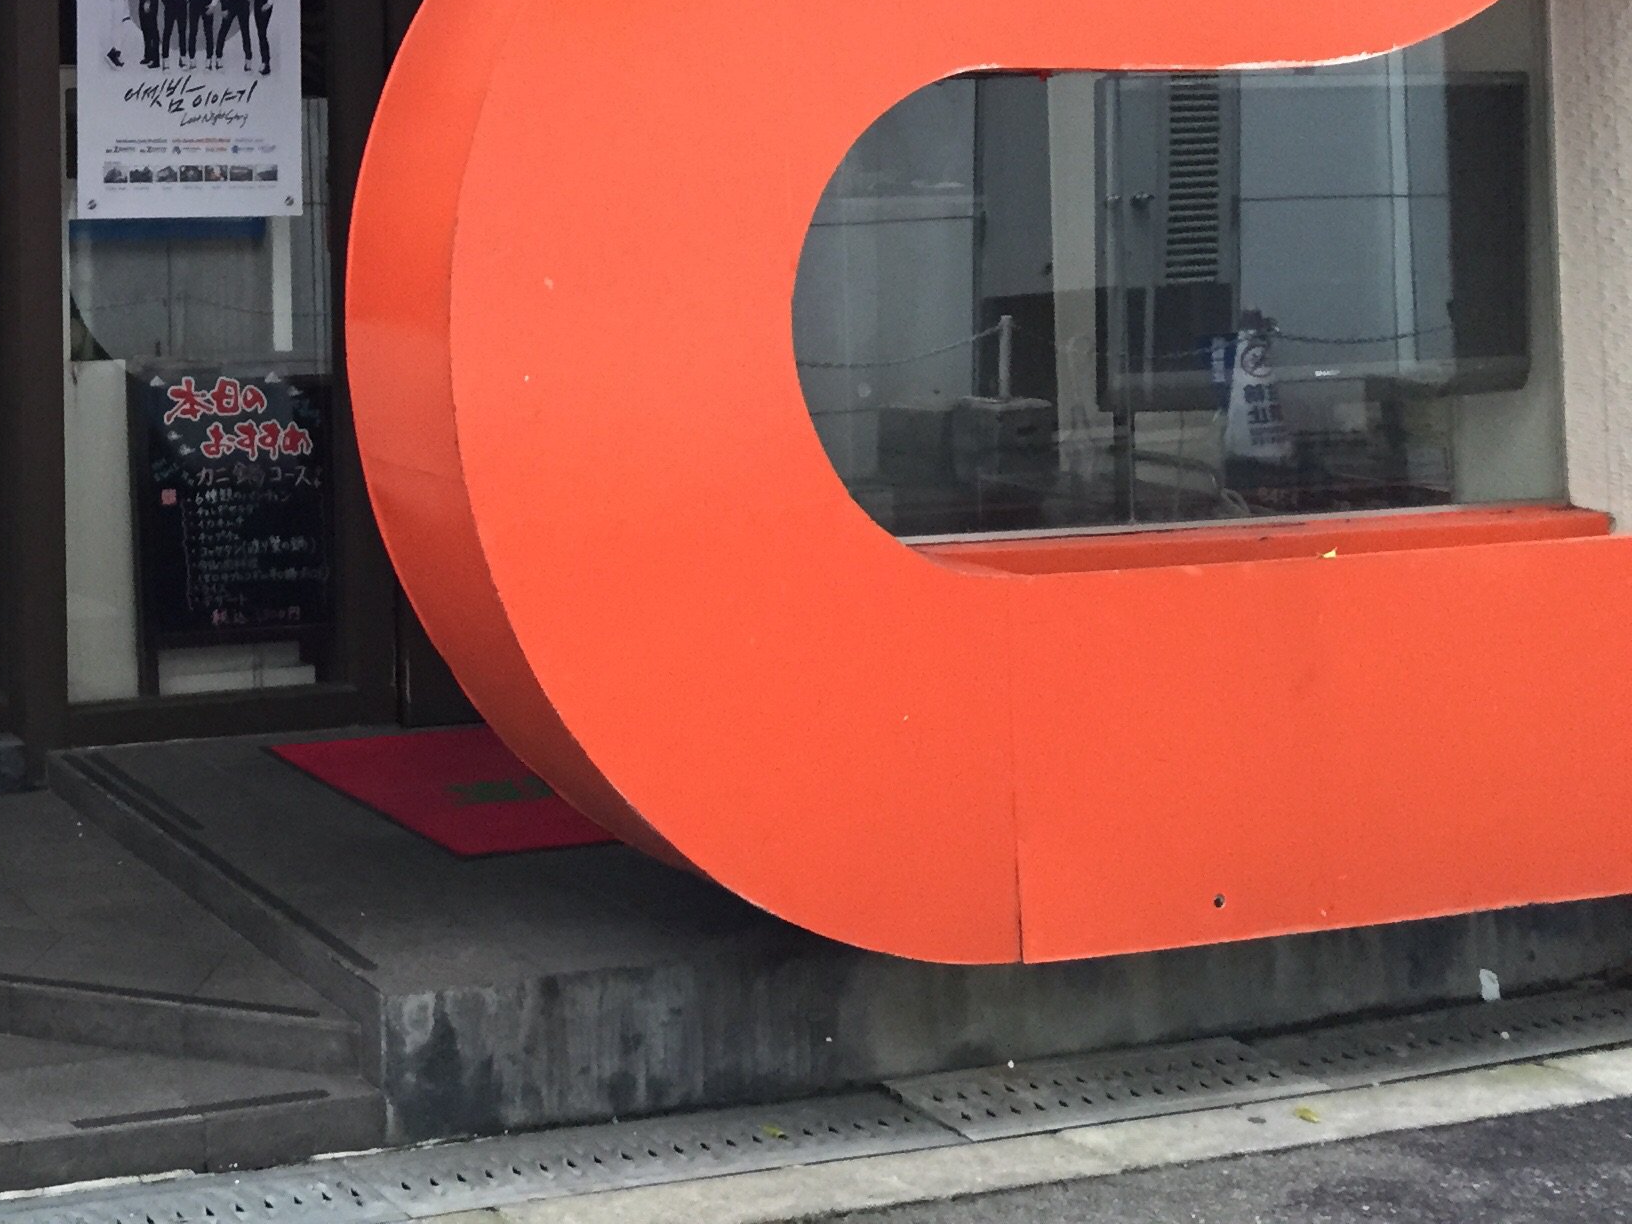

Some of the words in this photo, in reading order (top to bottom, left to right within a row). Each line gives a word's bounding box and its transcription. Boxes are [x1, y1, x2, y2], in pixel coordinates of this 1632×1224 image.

[164, 376, 268, 425] 本日の
[200, 419, 313, 462] おすすめ
